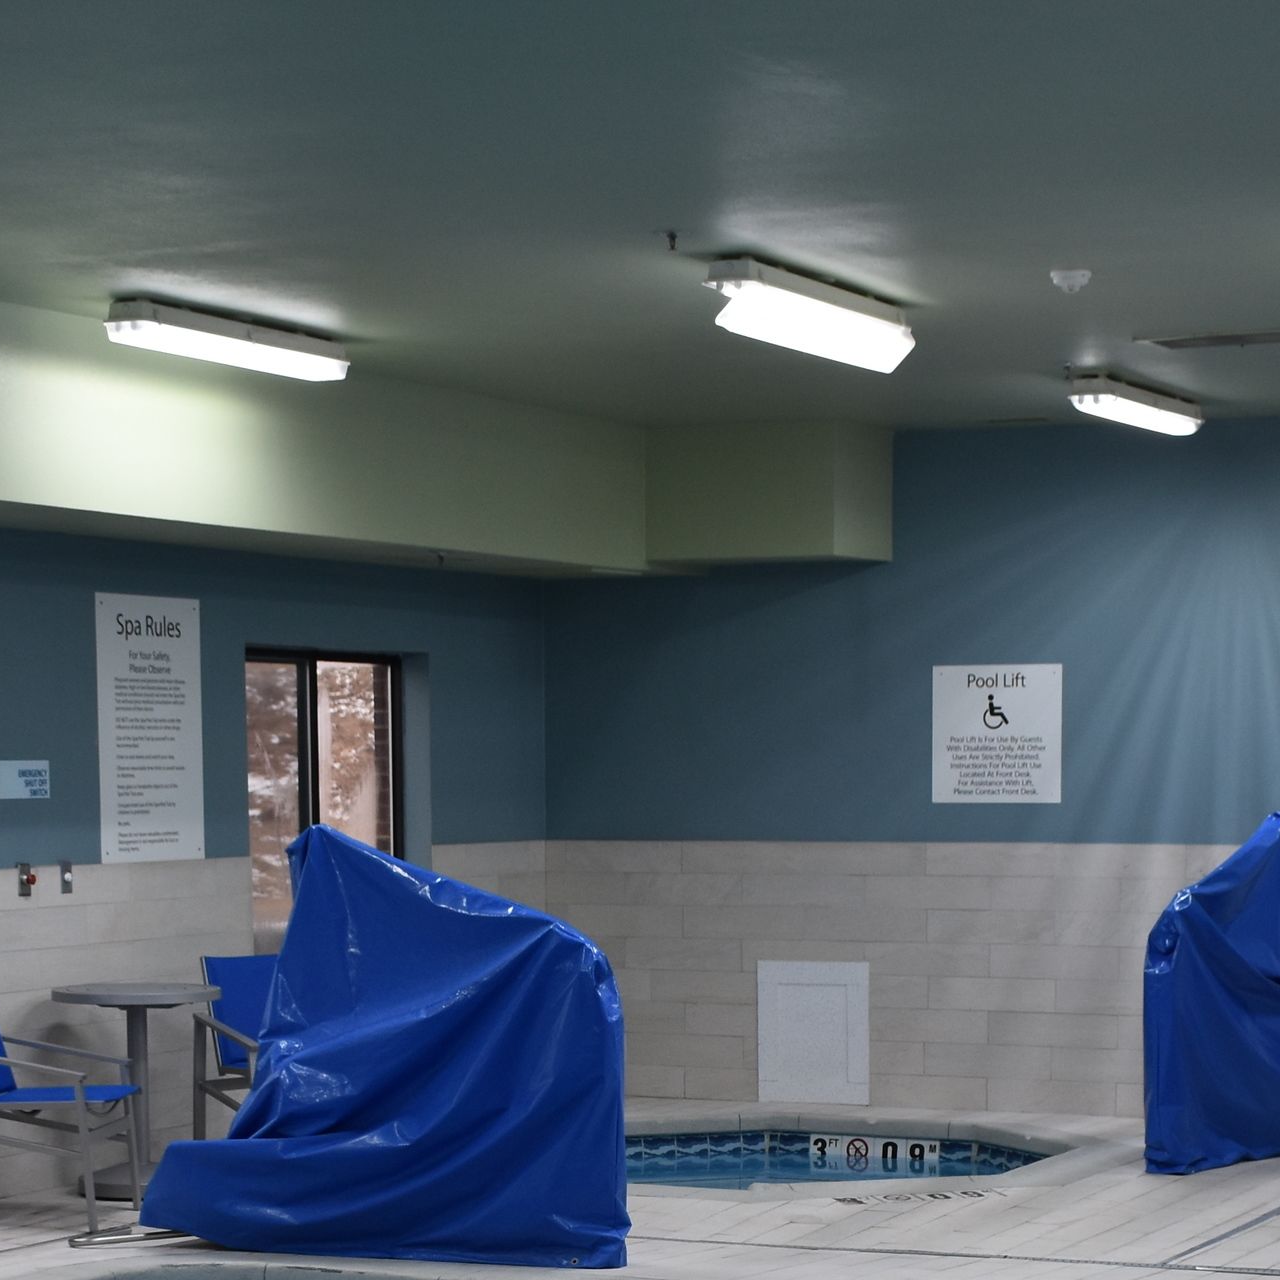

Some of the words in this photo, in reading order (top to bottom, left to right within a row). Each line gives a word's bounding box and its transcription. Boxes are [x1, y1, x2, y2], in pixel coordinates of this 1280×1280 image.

[116, 613, 142, 640] Spa
[145, 615, 182, 638] Rules
[128, 650, 138, 660] For
[967, 673, 999, 688] Pool
[1003, 673, 1026, 688] Lift
[813, 1138, 827, 1156] 3
[829, 1138, 839, 1147] FT
[929, 1144, 937, 1153] M
